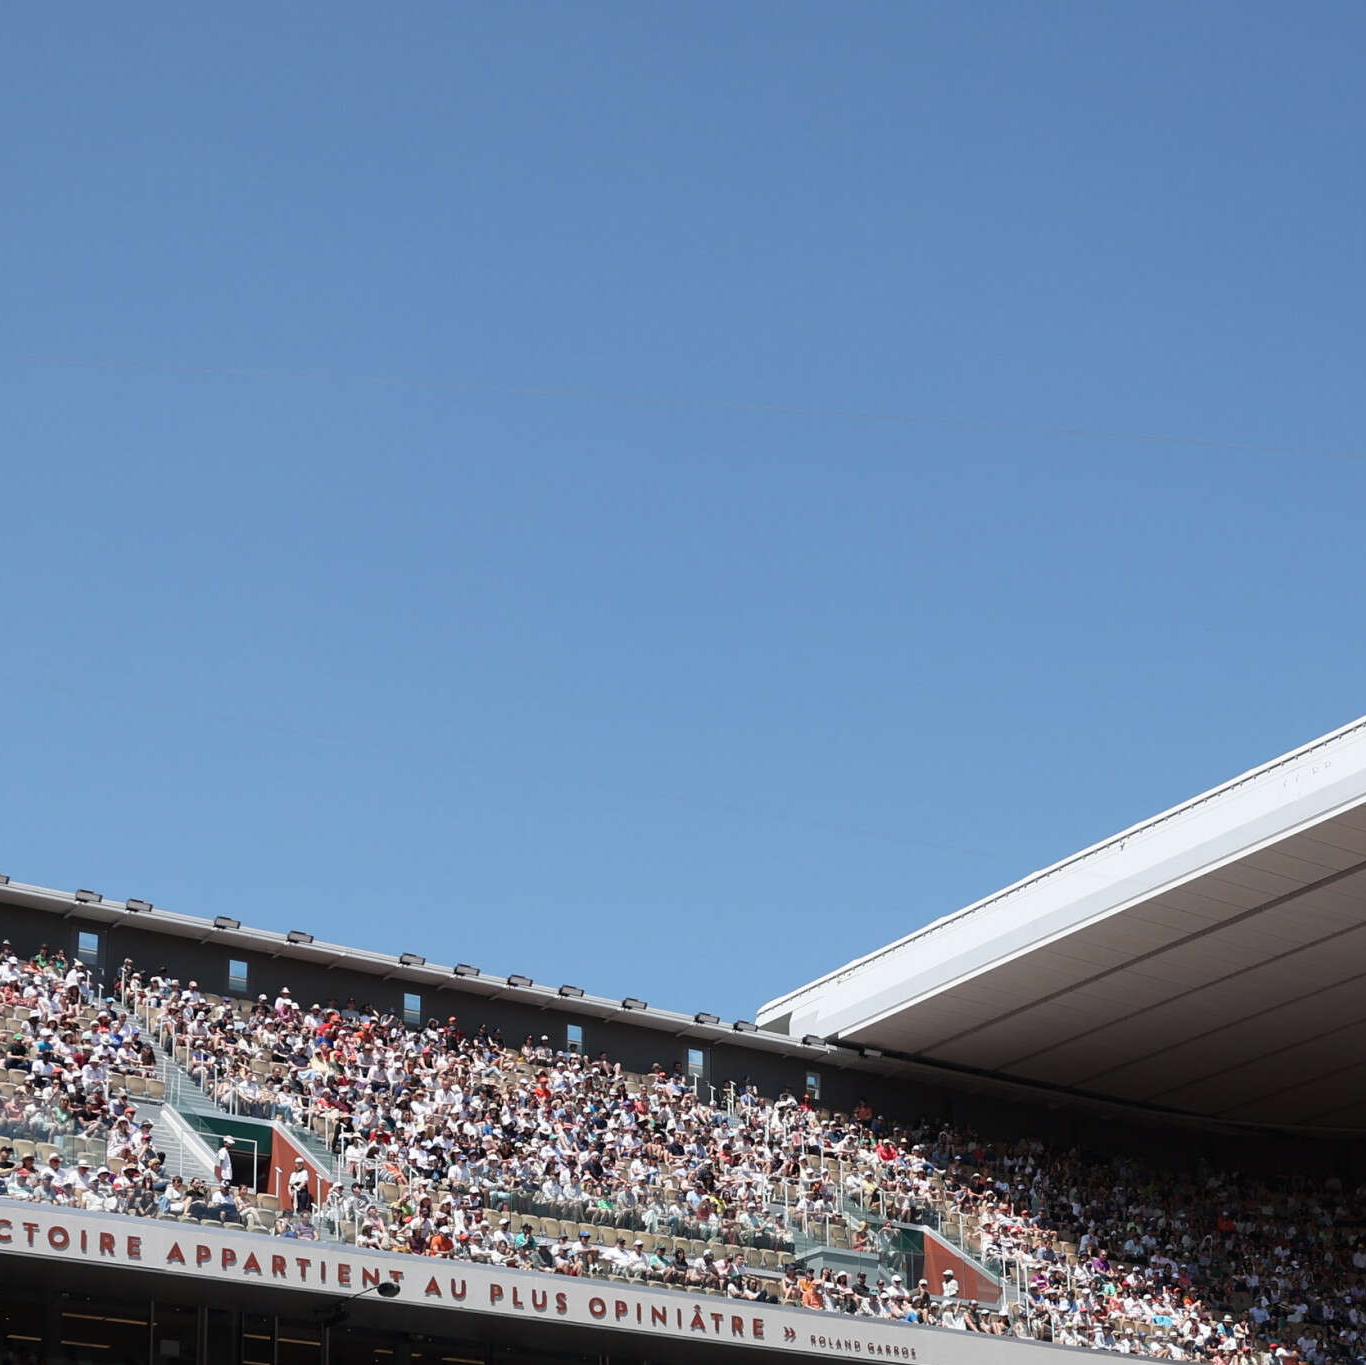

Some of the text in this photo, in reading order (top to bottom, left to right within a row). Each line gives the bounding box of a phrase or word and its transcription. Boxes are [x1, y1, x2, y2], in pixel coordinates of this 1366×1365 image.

[166, 1241, 404, 1290] APPARTIENT
[425, 1275, 467, 1303] AU
[489, 1283, 568, 1316] PLUS
[588, 1296, 766, 1340] OPINIÂTRE
[810, 1334, 916, 1360] ROLAND GARROS
